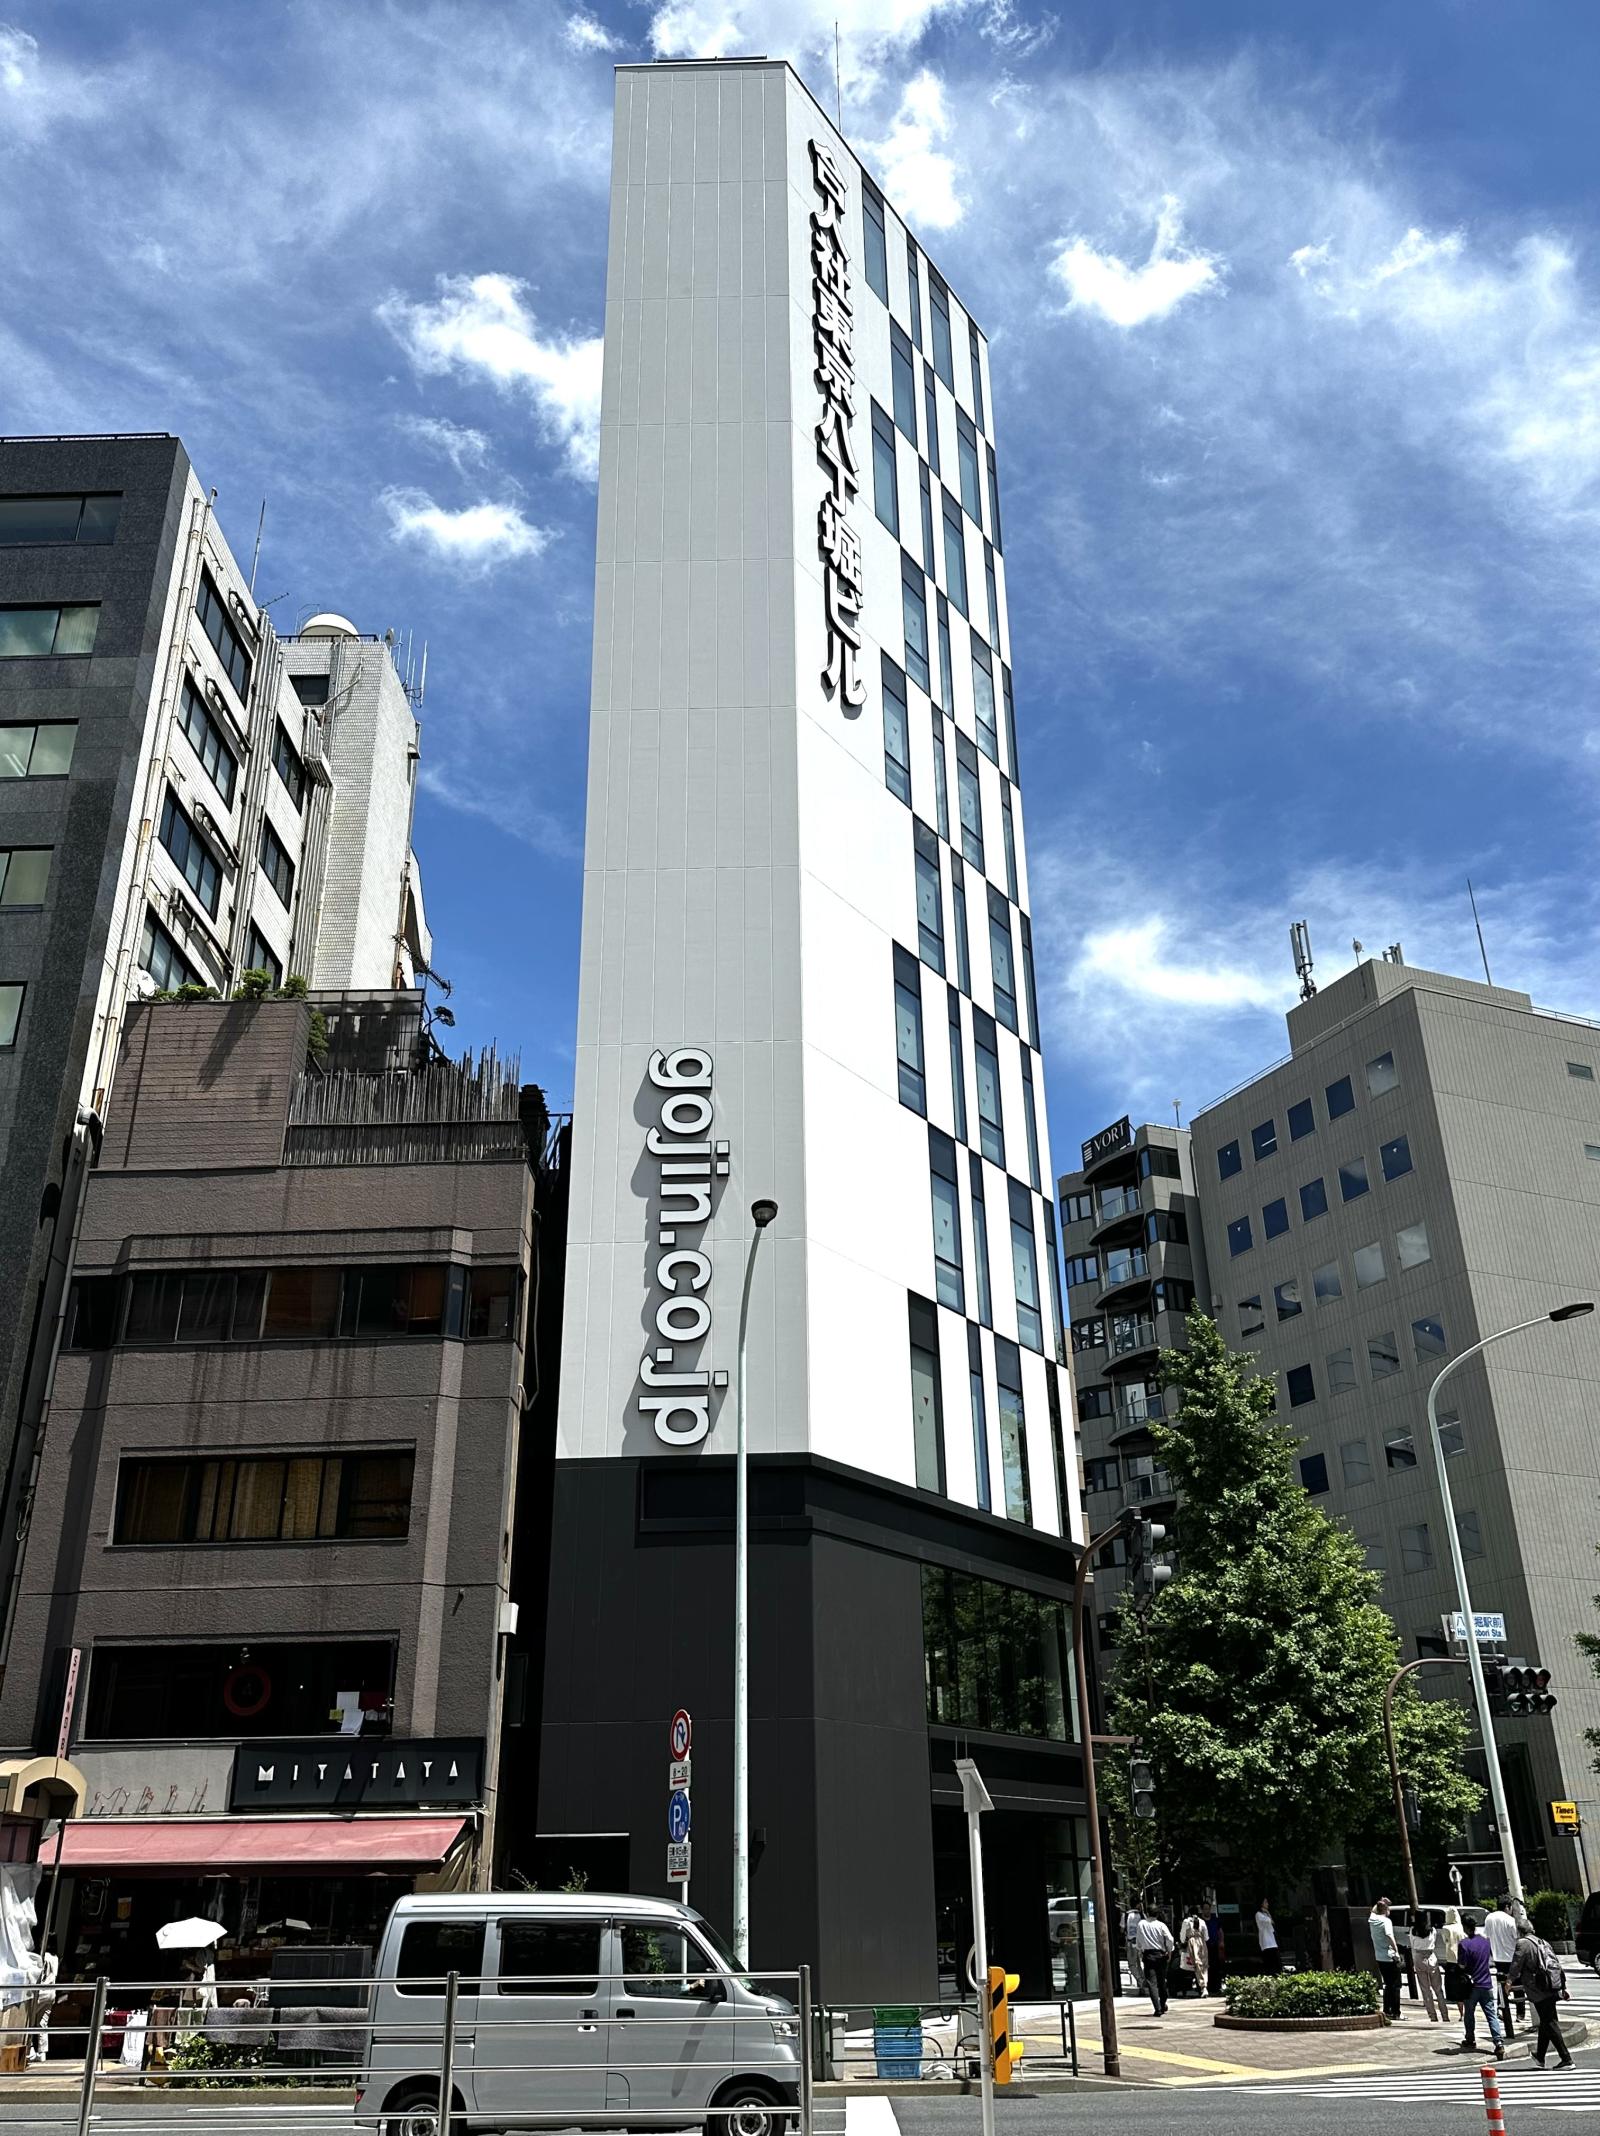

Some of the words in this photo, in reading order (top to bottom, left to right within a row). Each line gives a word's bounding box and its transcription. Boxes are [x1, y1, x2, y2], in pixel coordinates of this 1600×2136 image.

[808, 138, 867, 705] 合人社東京八丁堀ビル
[1094, 1121, 1125, 1151] VORT
[638, 1047, 730, 1446] gojin.co.jp
[1457, 1616, 1502, 1628] 八堀駅前
[258, 1760, 459, 1782] MIYATAYA
[673, 1804, 682, 1837] P
[1555, 1806, 1574, 1814] Times
